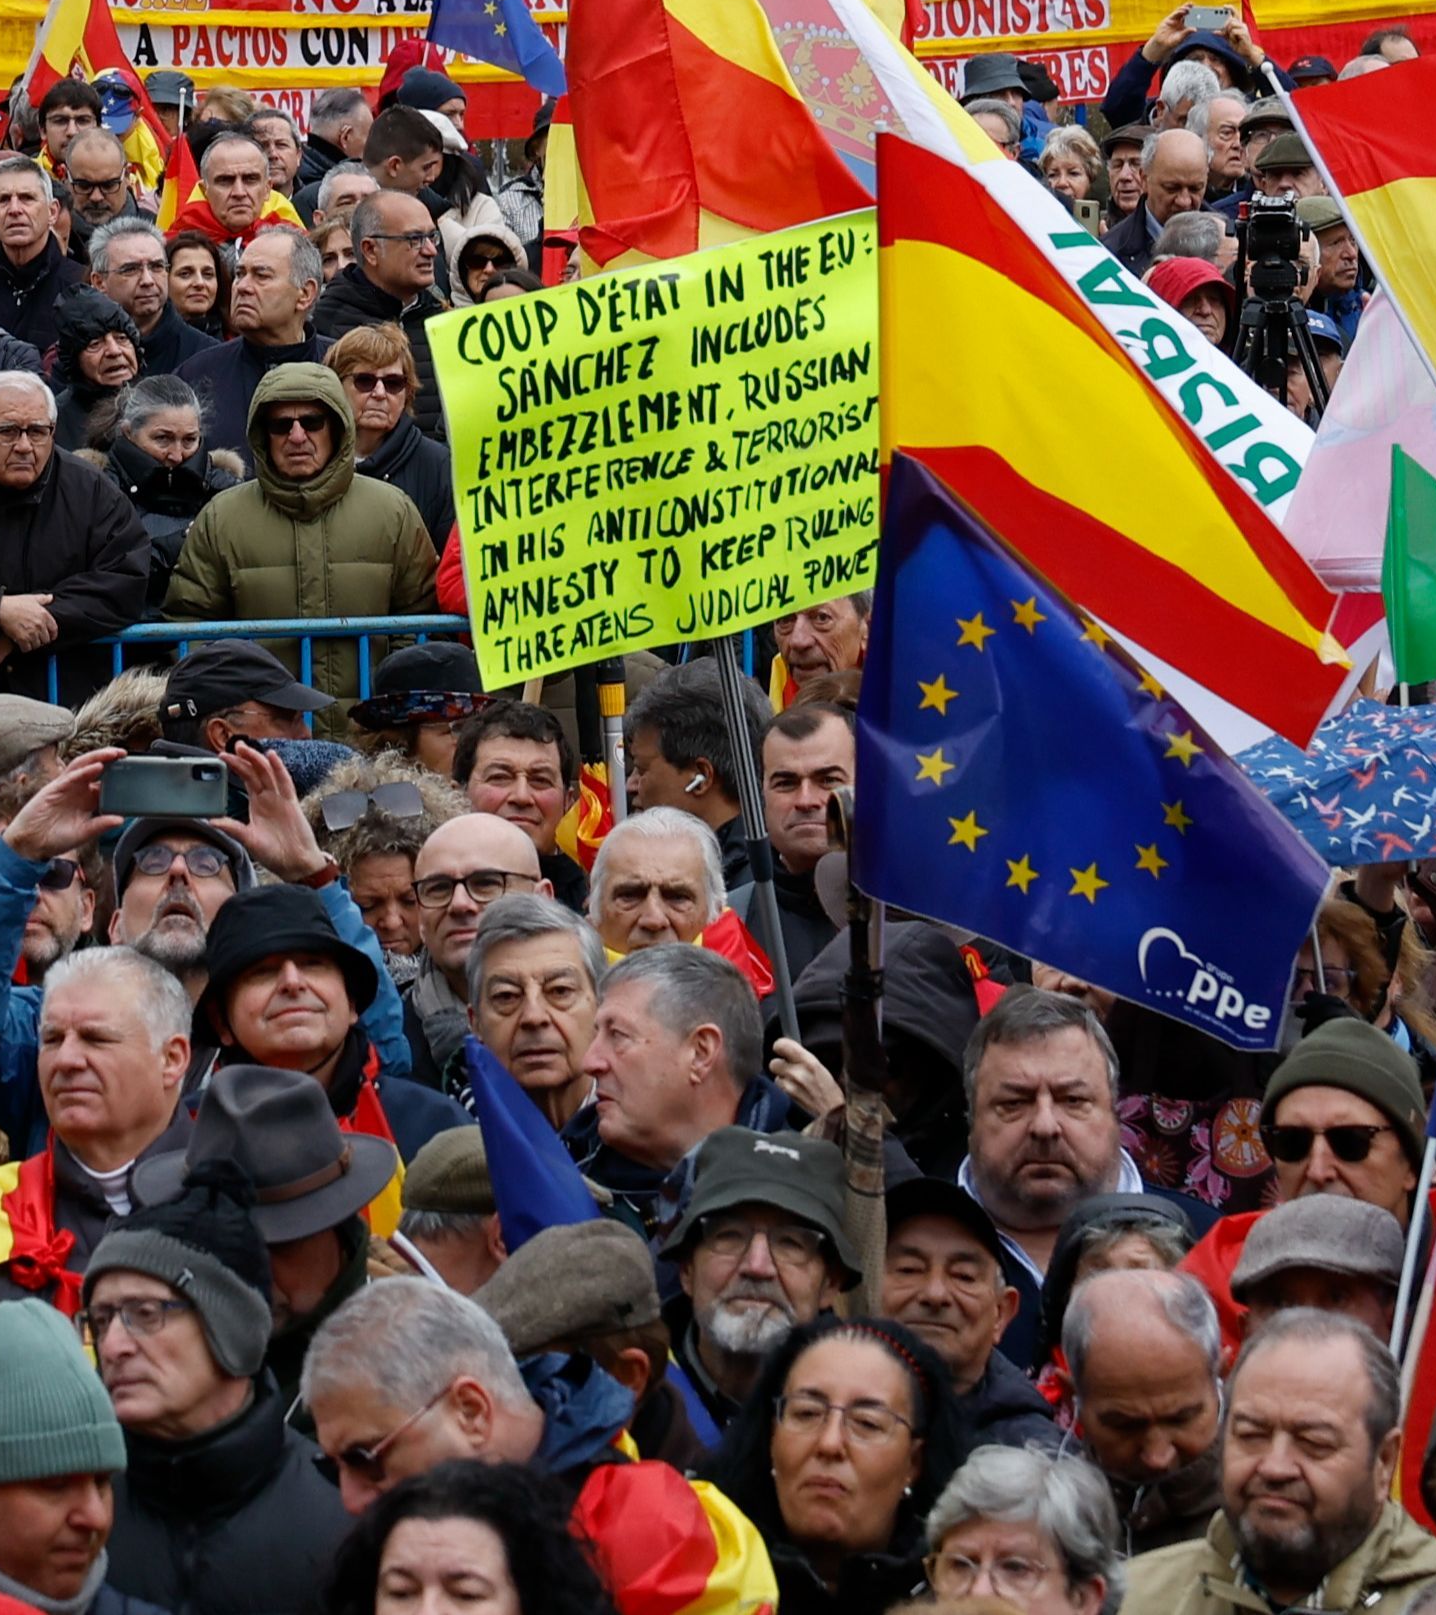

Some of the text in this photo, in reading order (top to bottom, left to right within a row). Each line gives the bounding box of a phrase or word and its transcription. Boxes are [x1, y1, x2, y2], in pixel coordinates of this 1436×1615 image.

[133, 22, 158, 66] A
[171, 24, 288, 66] PACTOS
[300, 26, 369, 66] CON
[458, 300, 558, 365] COUP
[705, 262, 744, 308] IN
[758, 245, 811, 291] THE
[497, 294, 826, 423] SÁNCHEZ INCLUDES
[739, 340, 871, 411] RUSSIAN
[466, 448, 695, 534] INTERFERENCE
[705, 439, 728, 473] &
[480, 448, 880, 582] IN HIS ANTICONSTITUTIONAL
[483, 559, 619, 636] AMNESTY
[636, 544, 682, 590] TO
[701, 523, 776, 579] KEEP
[494, 537, 879, 674] THREATENS JUDICIAL POWE
[1186, 969, 1271, 1028] ppe
